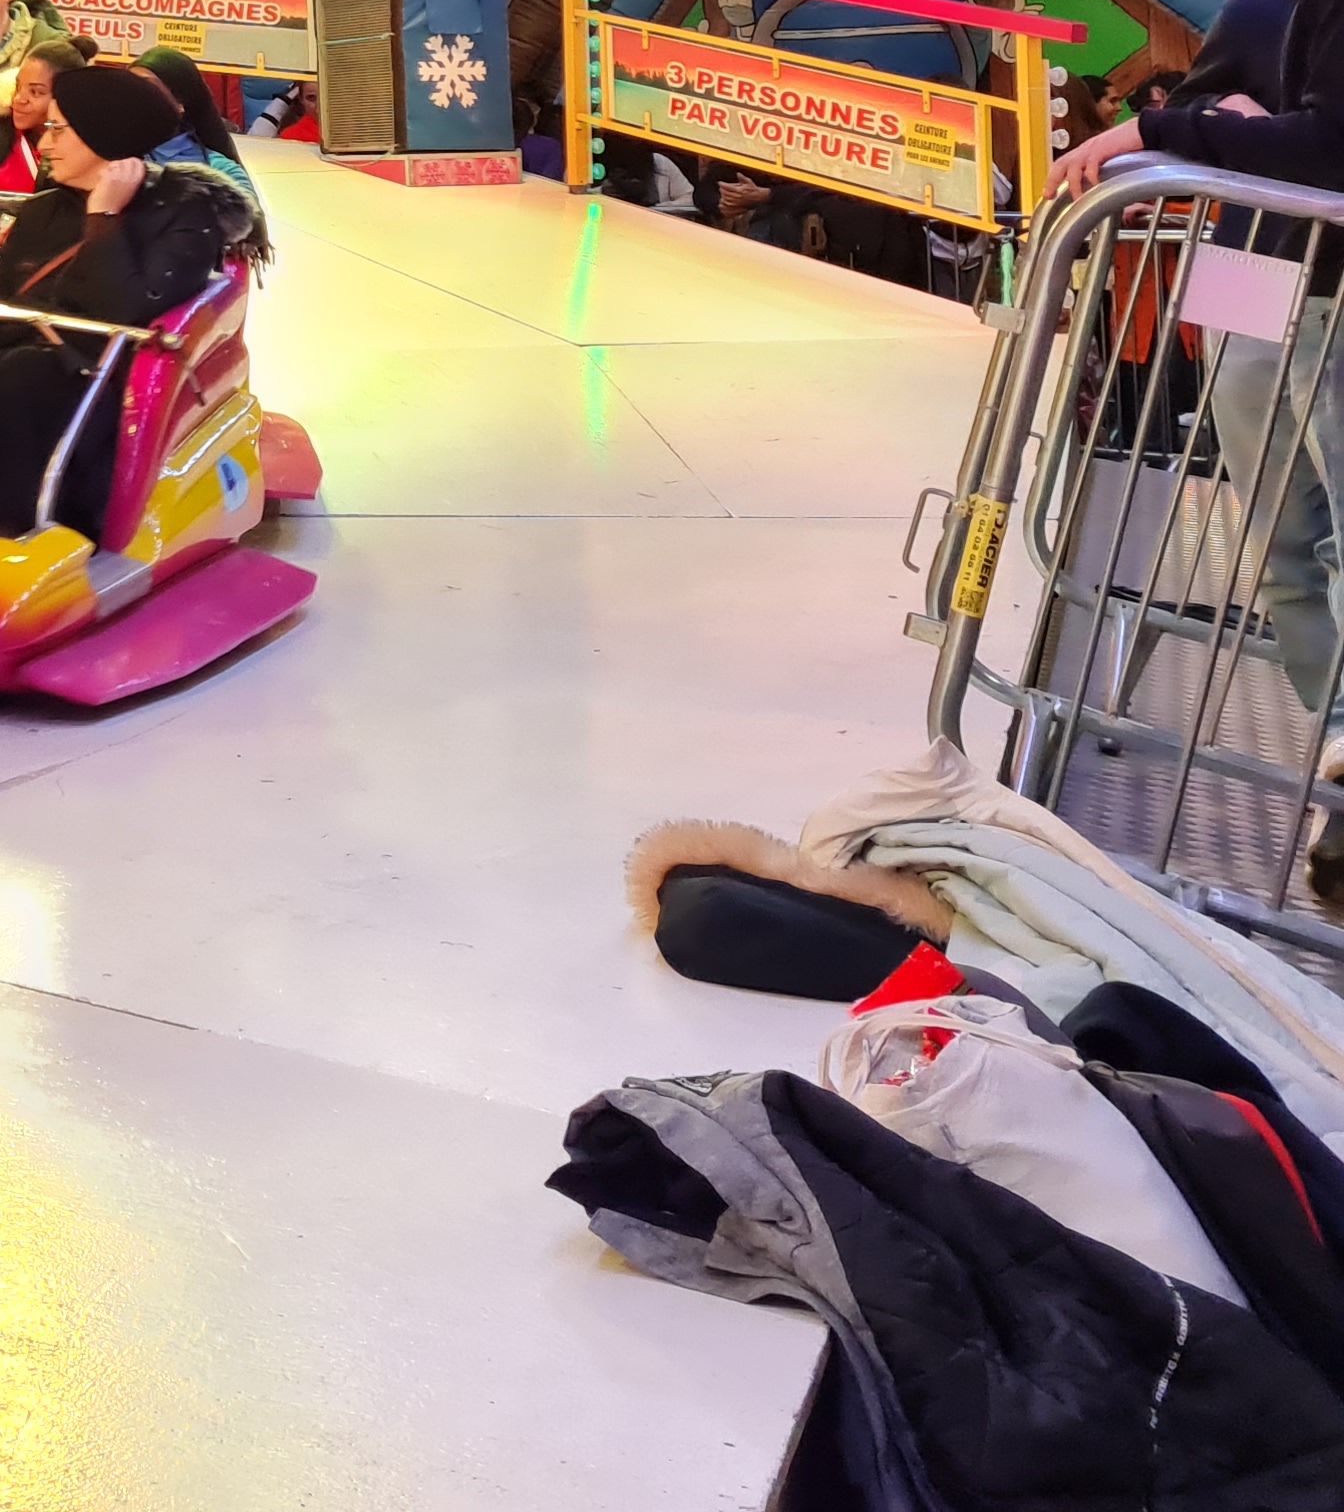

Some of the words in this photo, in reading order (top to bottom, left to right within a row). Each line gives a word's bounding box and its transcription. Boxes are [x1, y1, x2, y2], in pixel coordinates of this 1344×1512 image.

[64, 15, 143, 40] SEULS
[667, 63, 686, 86] 3
[695, 69, 901, 137] PERSONNES
[669, 96, 730, 130] PAR
[739, 113, 893, 173] VOITURE
[914, 123, 949, 139] CEINTURE
[907, 137, 953, 156] OBLIGATOIRE
